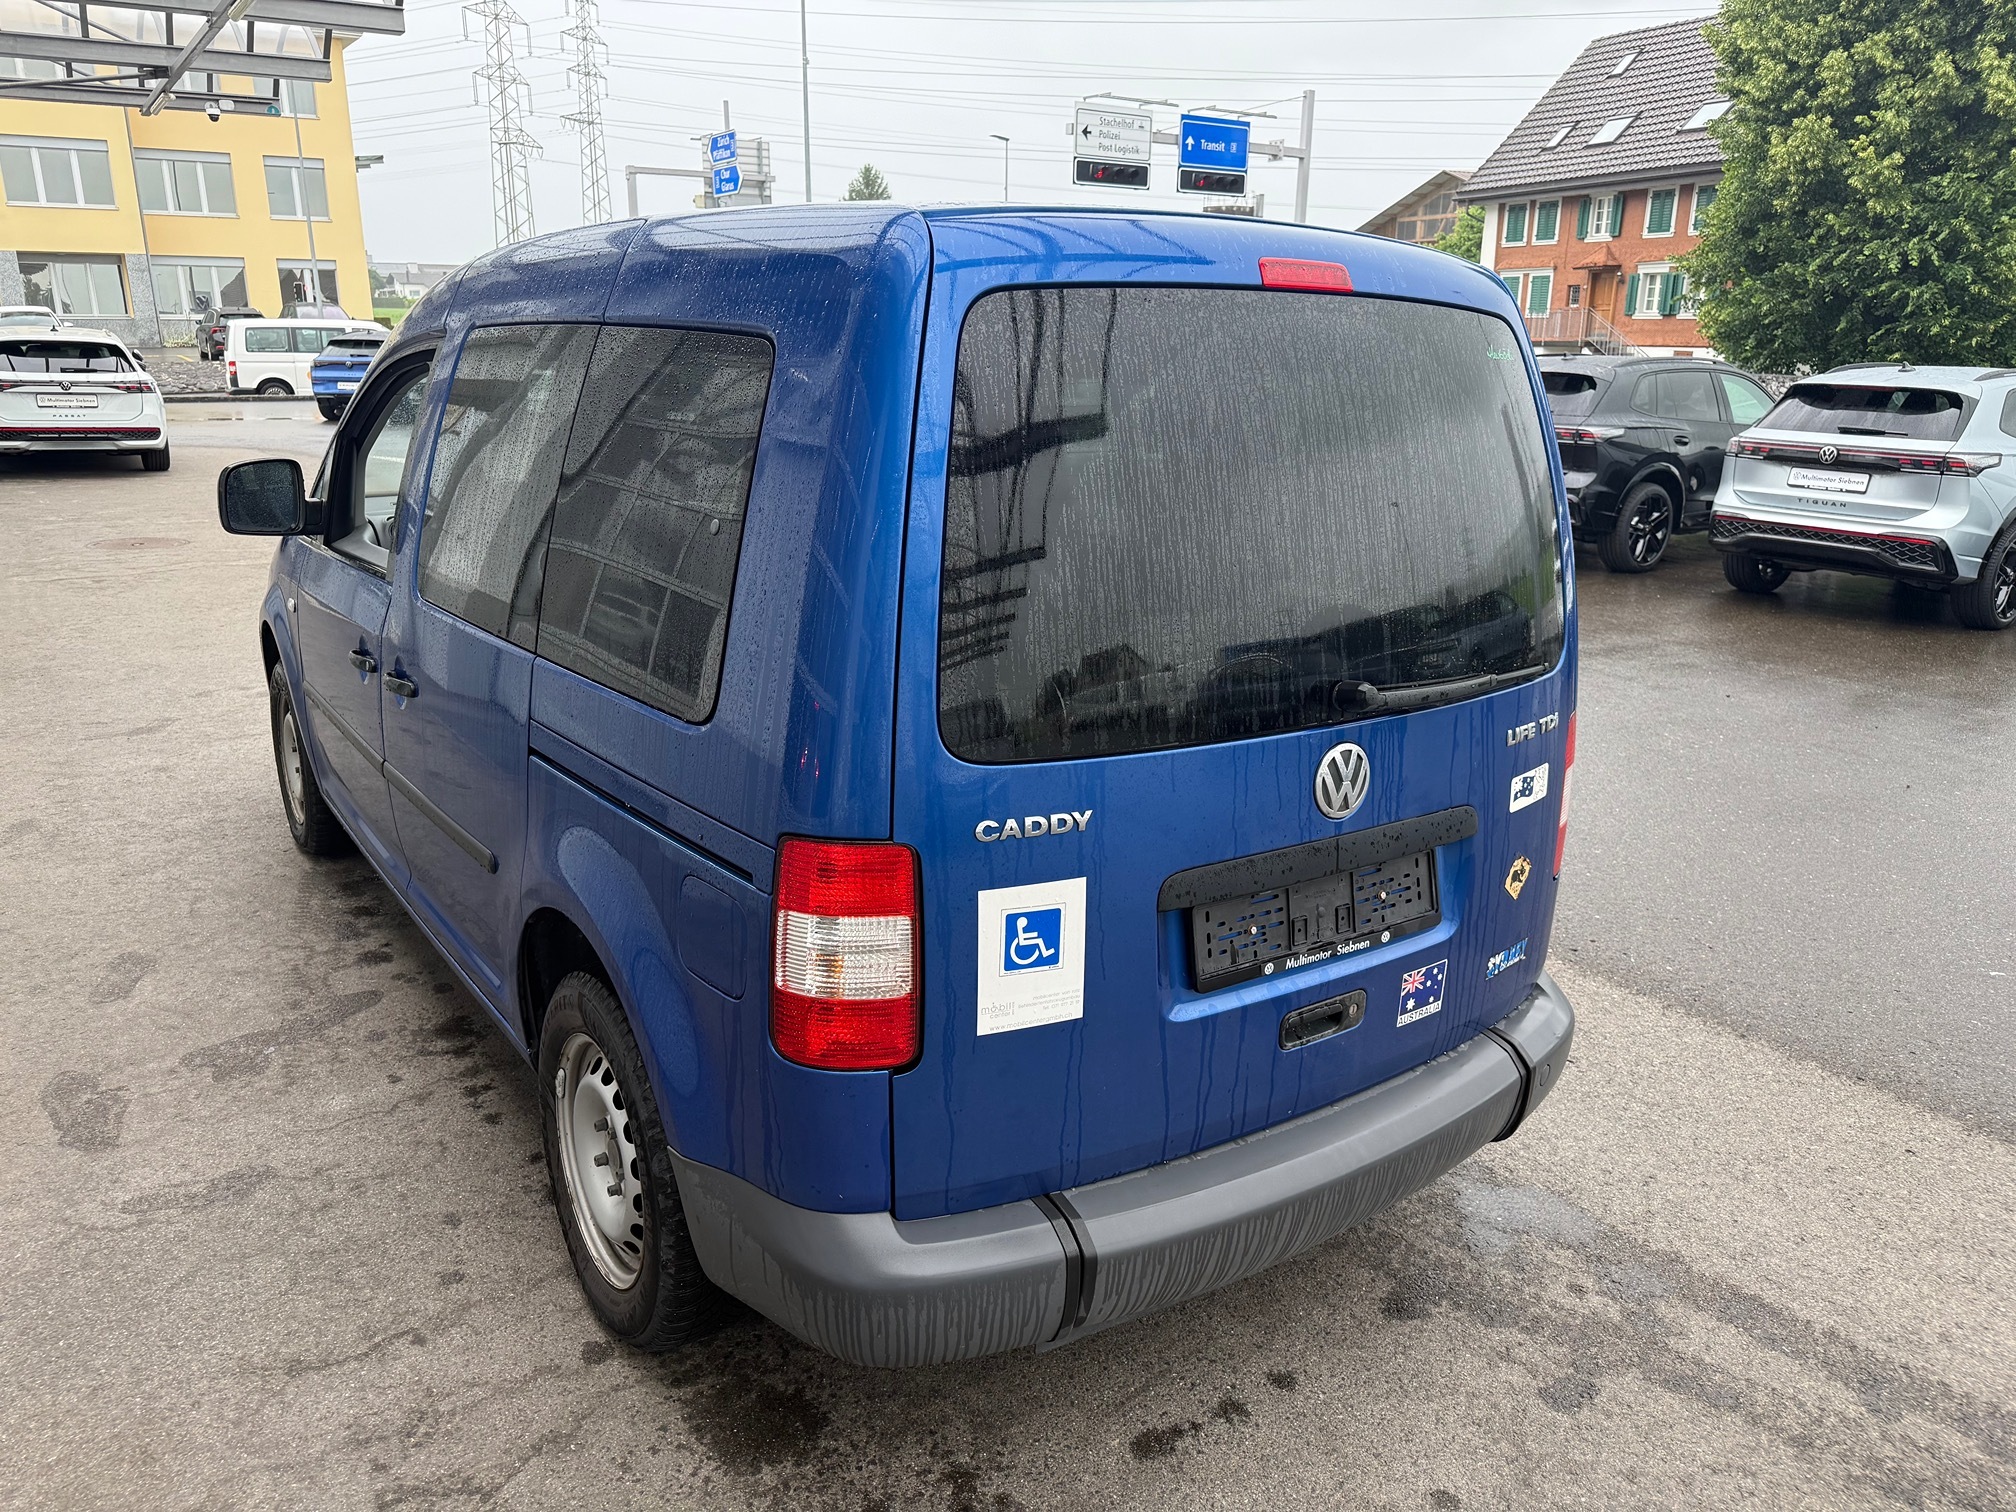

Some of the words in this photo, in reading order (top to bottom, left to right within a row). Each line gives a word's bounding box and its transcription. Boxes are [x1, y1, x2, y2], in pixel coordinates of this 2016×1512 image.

[1099, 116, 1135, 129] Stachelhof
[1098, 130, 1121, 141] Polizei
[1098, 142, 1113, 152] Post
[1114, 144, 1140, 156] Logistik
[1200, 139, 1226, 152] Transit
[1800, 474, 1837, 484] Multimotor
[1837, 477, 1865, 486] Siebnen
[1797, 498, 1847, 508] TIGUAN
[1506, 721, 1536, 747] LIFE
[974, 809, 1094, 843] CADDY
[1285, 949, 1333, 970] Multimotor
[1336, 940, 1370, 956] Siebnen
[1398, 1002, 1441, 1026] AUSTRALIA
